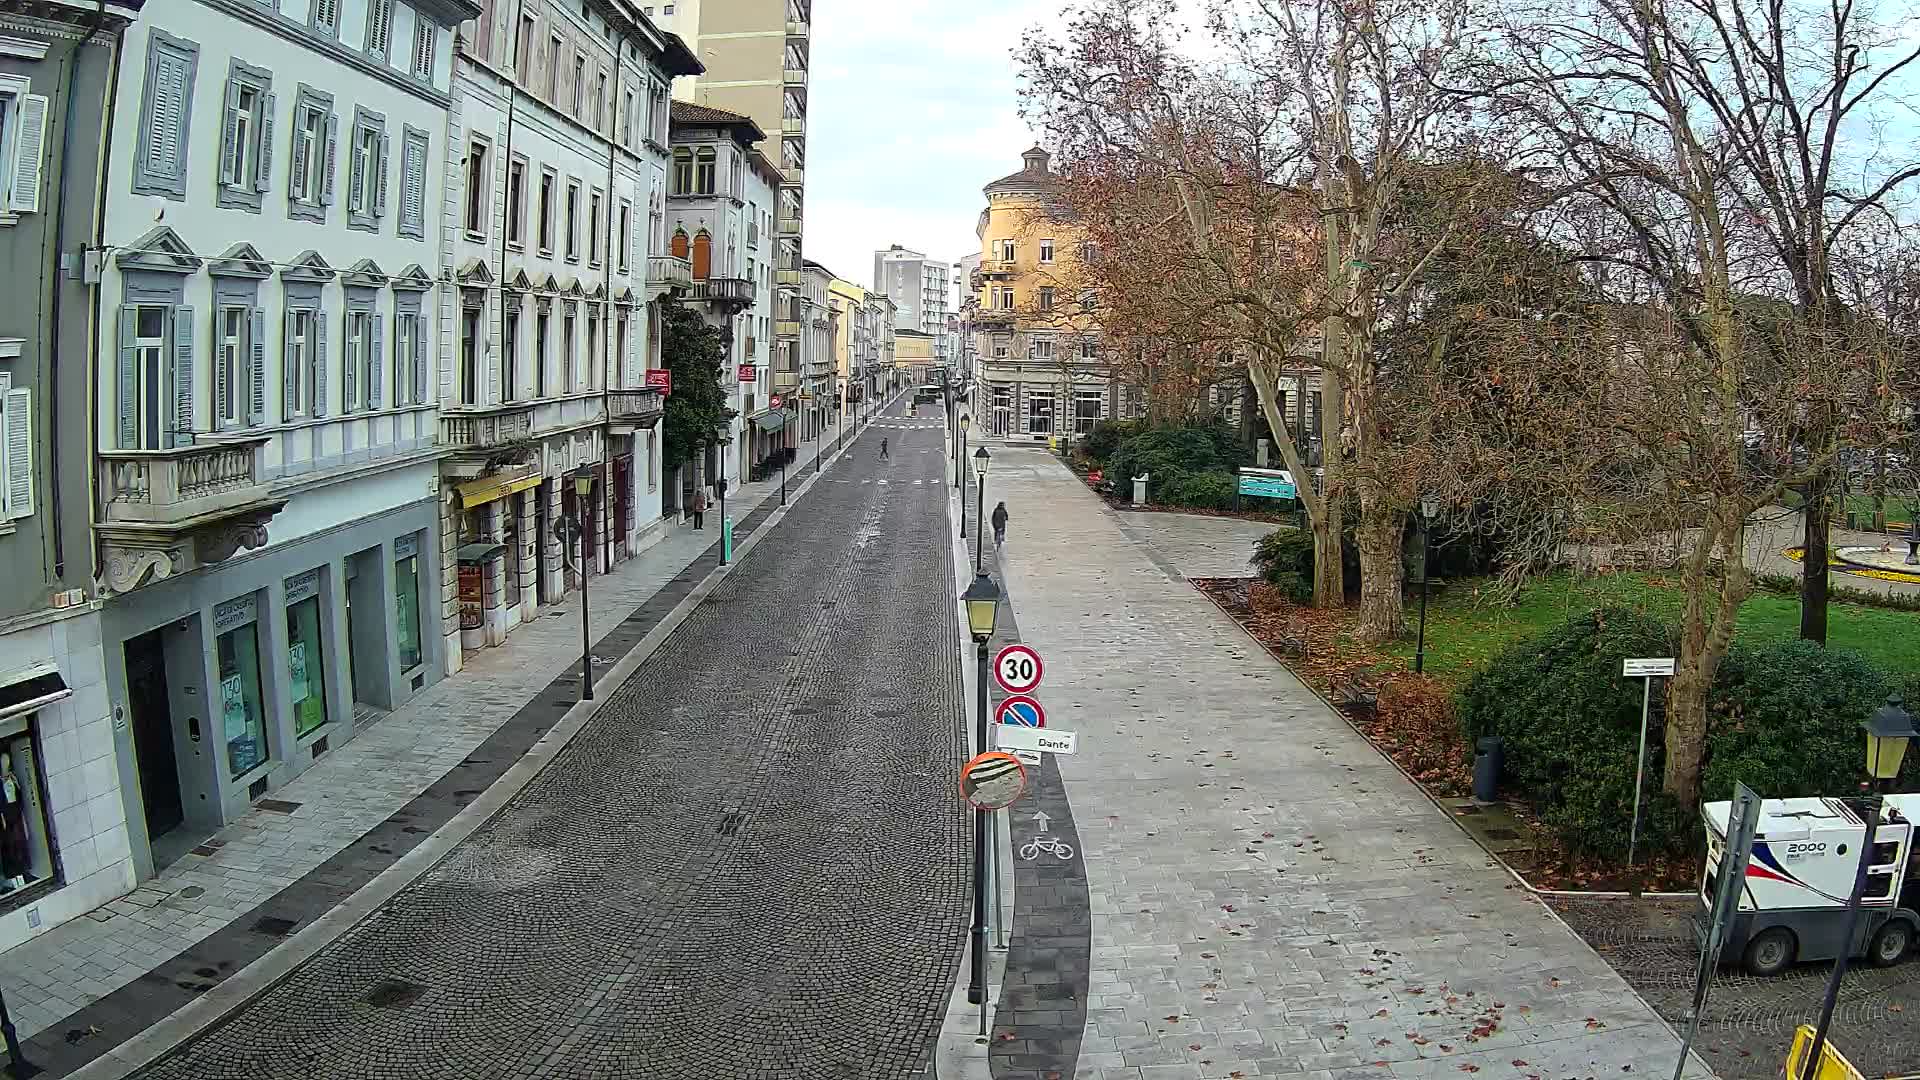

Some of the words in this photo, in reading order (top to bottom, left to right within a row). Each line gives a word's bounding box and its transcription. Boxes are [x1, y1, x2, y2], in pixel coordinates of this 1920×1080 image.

[1005, 659, 1033, 680] 30
[1038, 738, 1070, 749] Dante
[1787, 842, 1827, 853] 2000
